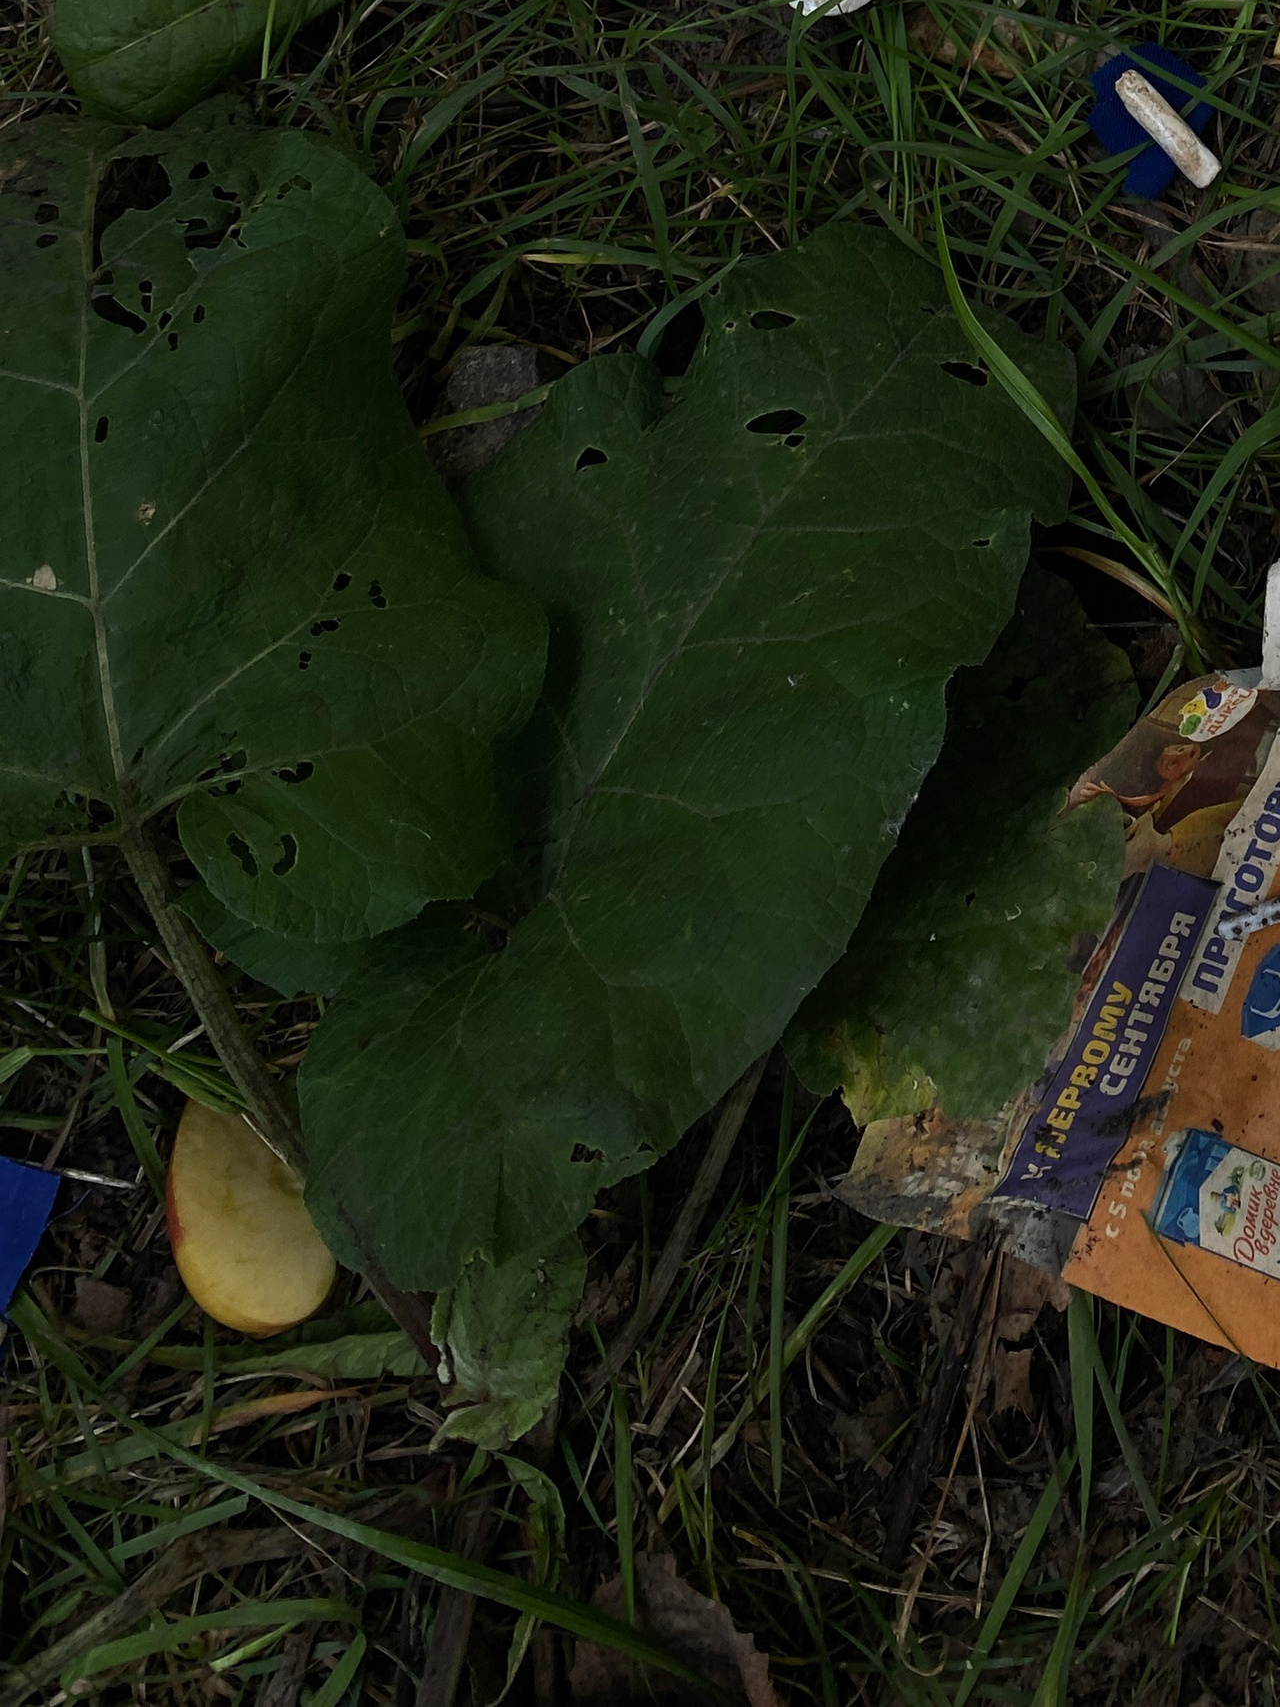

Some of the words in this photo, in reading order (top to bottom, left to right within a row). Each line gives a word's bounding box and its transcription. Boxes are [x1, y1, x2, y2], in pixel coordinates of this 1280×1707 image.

[1100, 912, 1196, 1096] СЕНТЯБРЯ
[1151, 1038, 1193, 1135] ауста
[1106, 1224, 1120, 1238] с
[1109, 1200, 1127, 1219] 5
[1233, 1184, 1264, 1263] Домик
